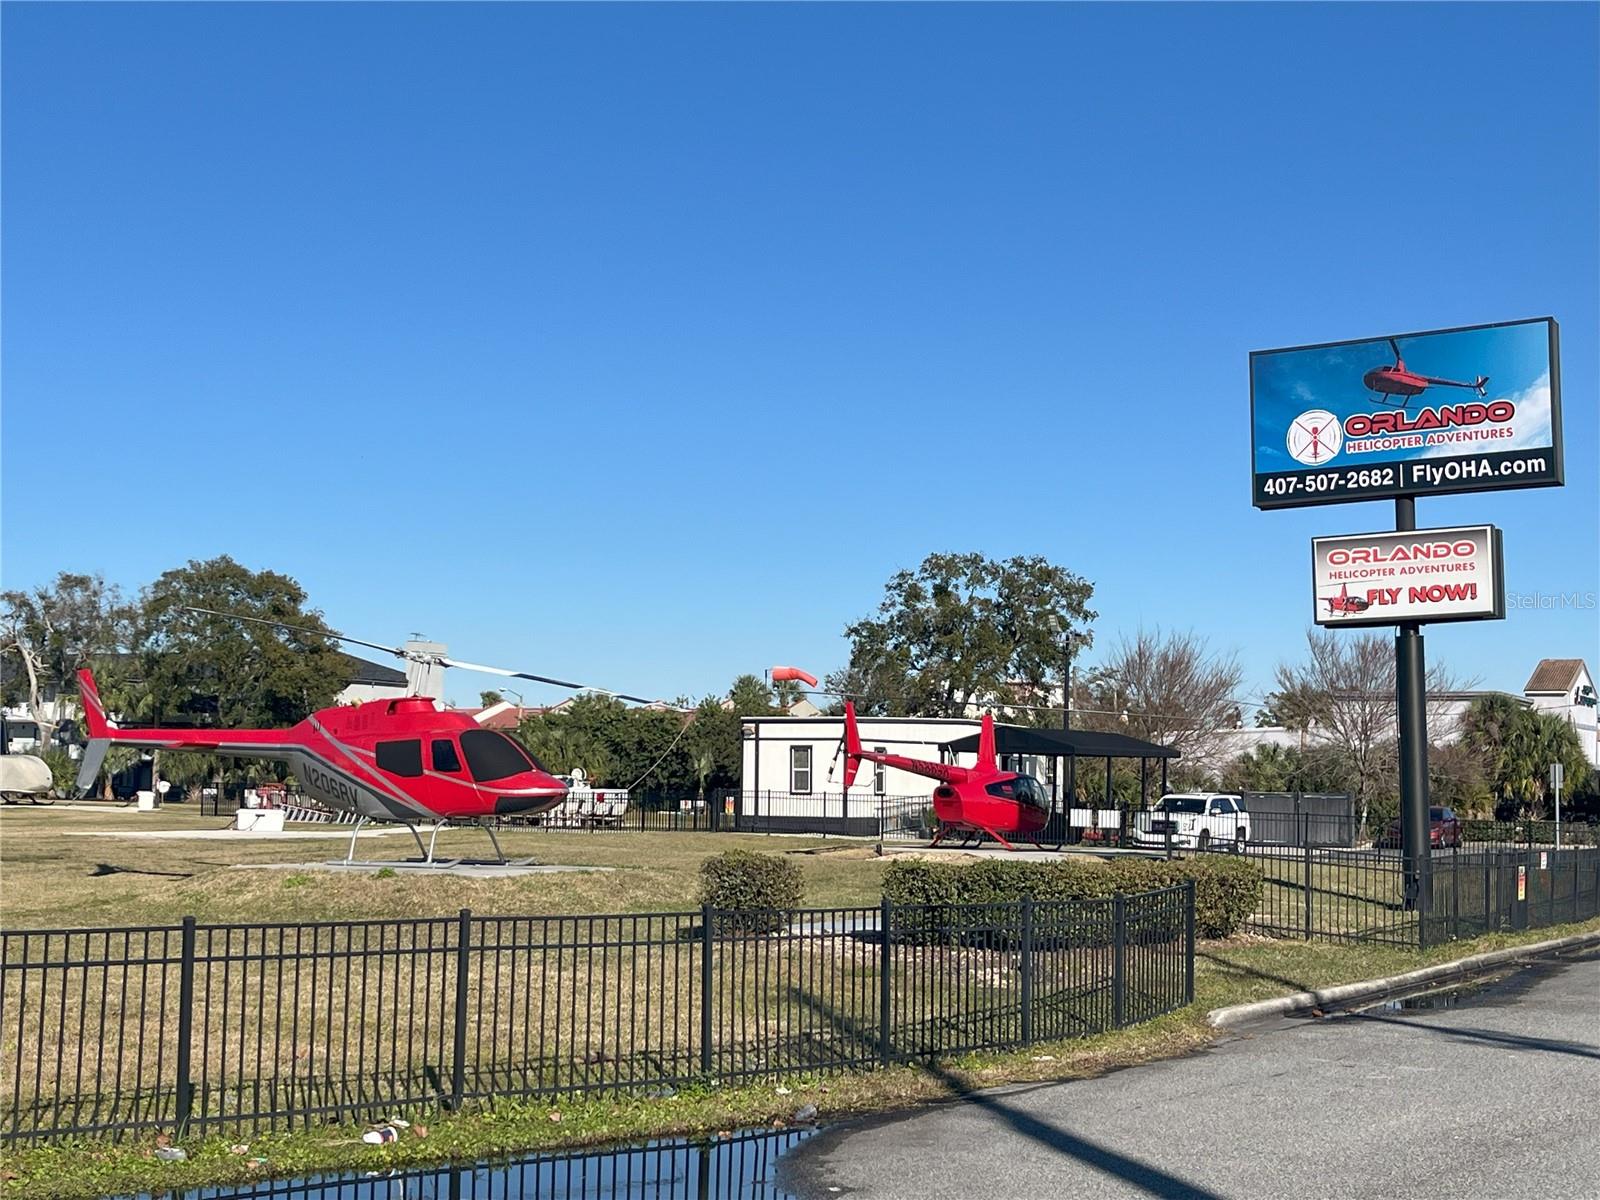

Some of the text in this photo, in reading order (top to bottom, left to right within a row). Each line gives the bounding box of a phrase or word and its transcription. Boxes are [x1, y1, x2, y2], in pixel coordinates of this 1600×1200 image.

[1345, 401, 1515, 437] ORLANDO
[1347, 427, 1514, 453] HELICOPTER ADVENTURES
[1263, 469, 1394, 495] 407-507-2682
[1412, 457, 1547, 486] FlyOHA.com
[1328, 541, 1476, 565] ORLANDO
[1329, 562, 1476, 580] HELICOPTER ADVENTURES
[1366, 583, 1478, 606] FLY NOW!
